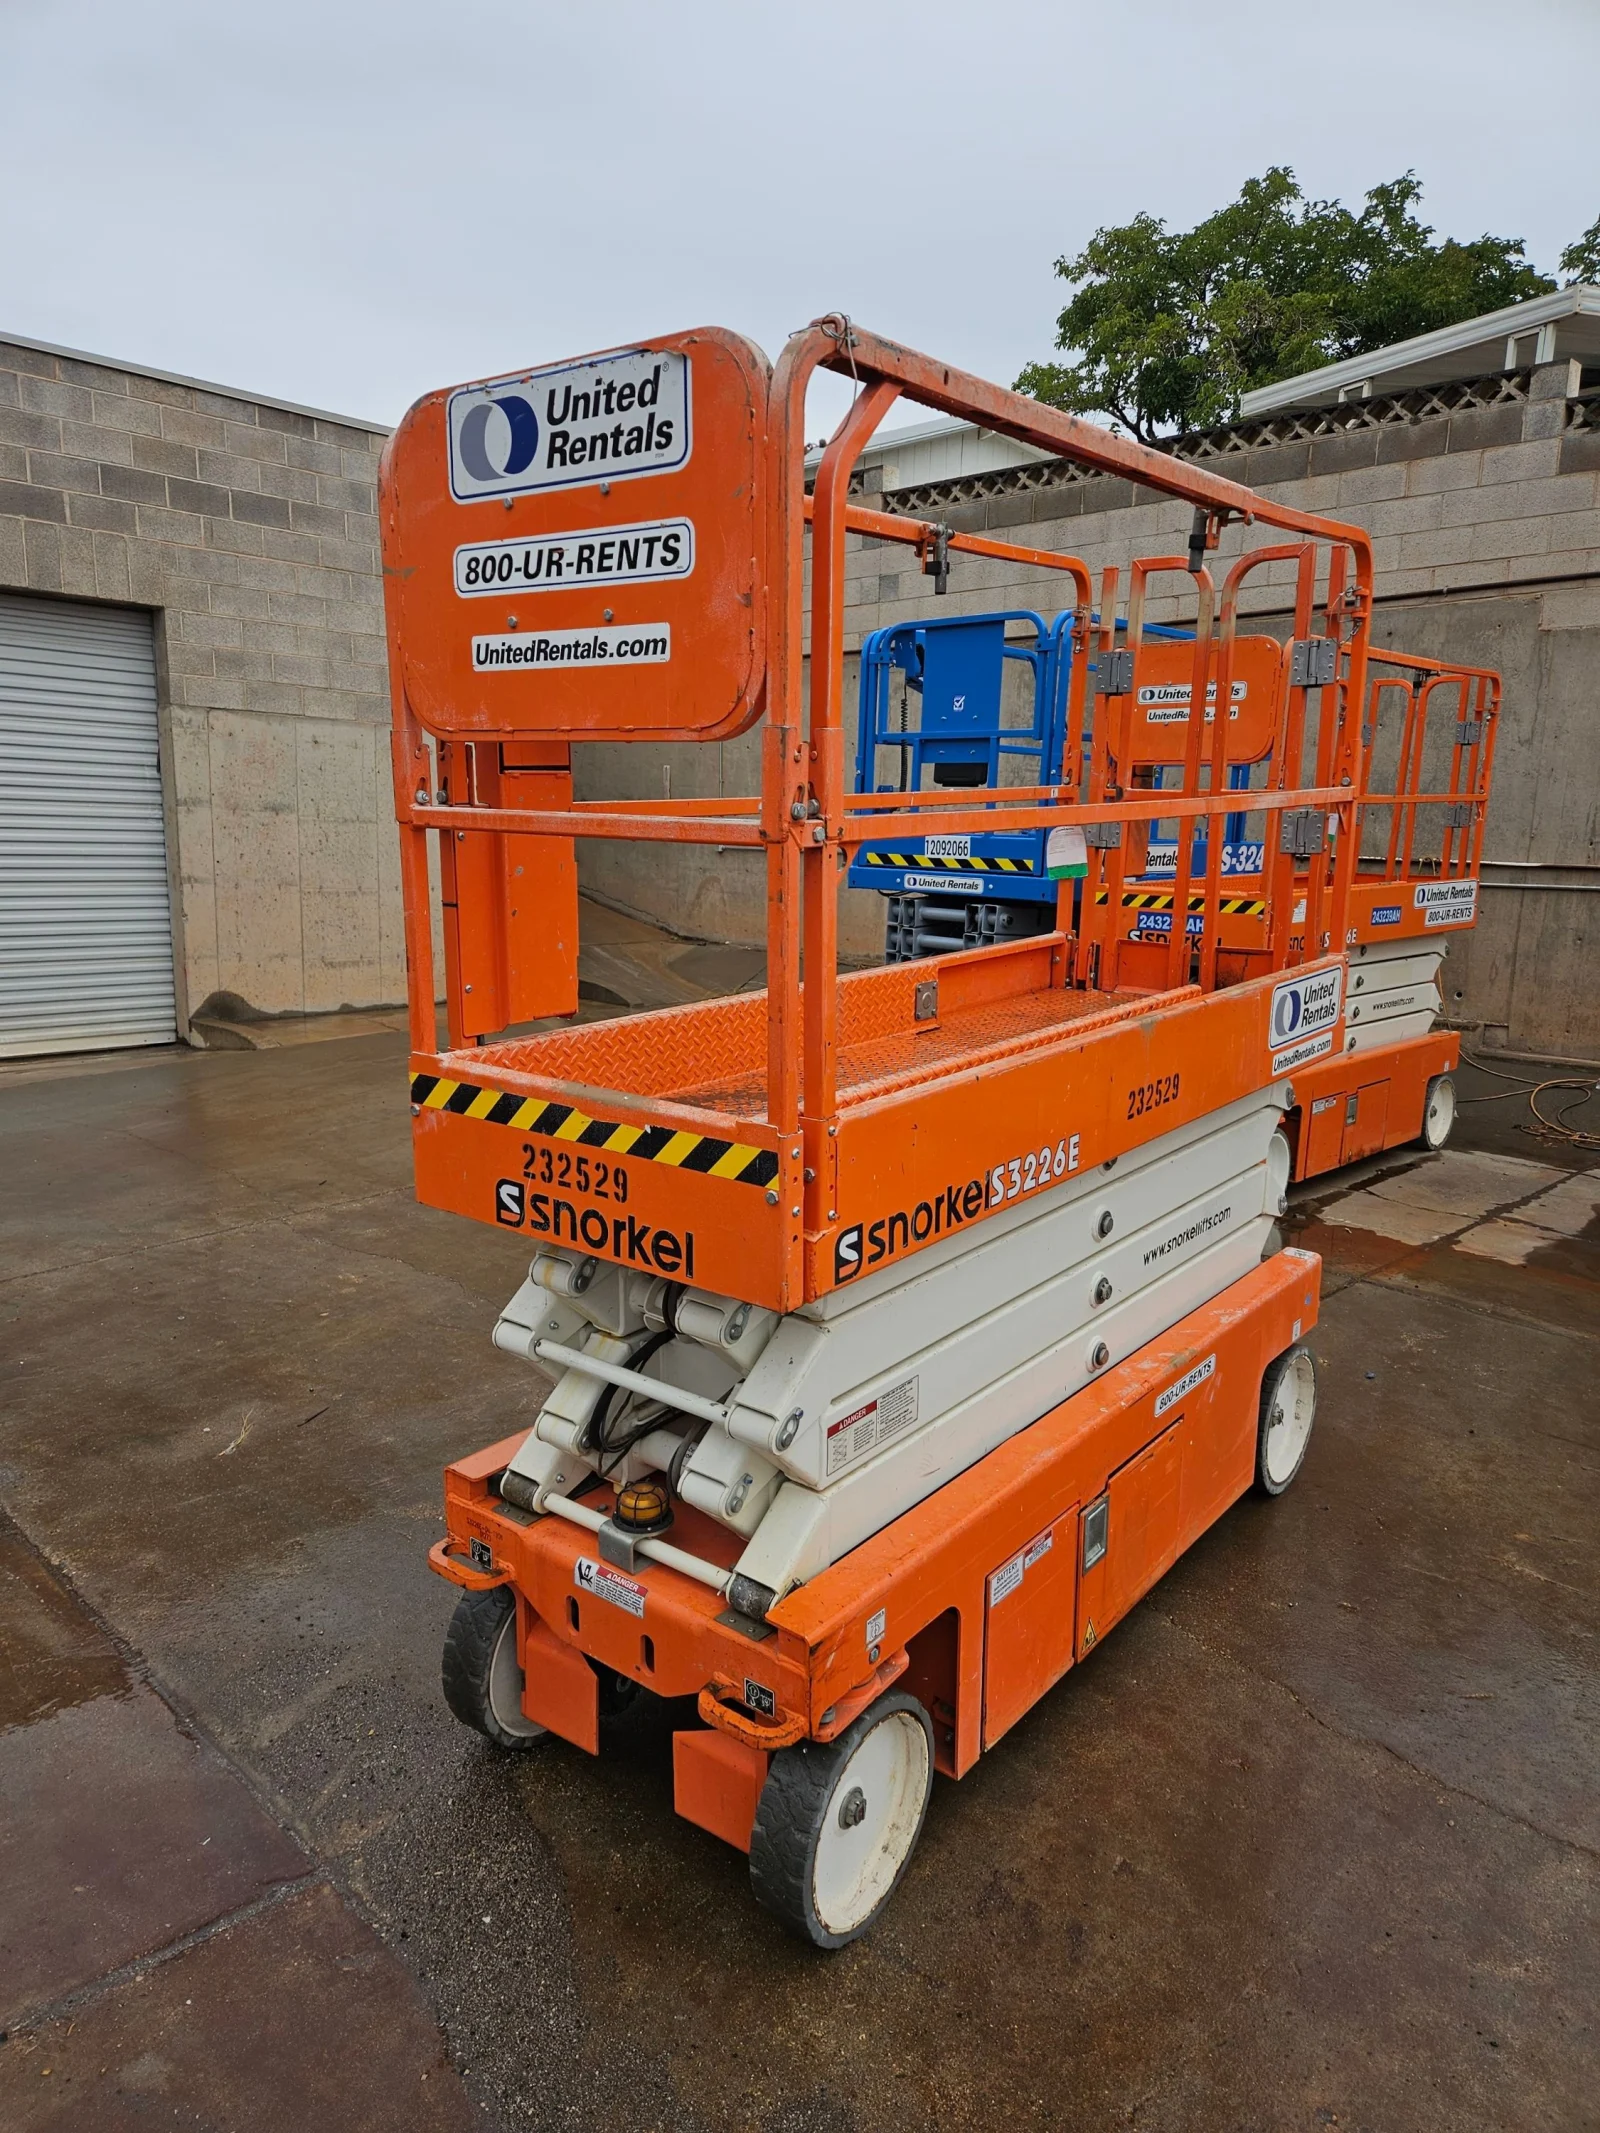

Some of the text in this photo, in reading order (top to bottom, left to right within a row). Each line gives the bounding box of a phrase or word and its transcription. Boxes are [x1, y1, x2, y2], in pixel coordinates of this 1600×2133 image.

[546, 364, 661, 426] United
[546, 411, 674, 469] Rentals
[465, 533, 682, 585] 800-UR-RENTS
[475, 635, 668, 665] UnitedRentals.com
[925, 839, 969, 857] 12092066
[918, 877, 979, 891] United Rentals
[1426, 884, 1474, 903] United Rentals
[1427, 906, 1473, 923] 800-UR-RENTS
[1303, 976, 1336, 1006] United
[1301, 998, 1336, 1028] Rentals
[1273, 1038, 1331, 1073] UnitedRentals.com
[1127, 1072, 1180, 1121] 232529
[522, 1143, 628, 1204] 232529
[867, 1169, 991, 1265] snorkel
[989, 1132, 1081, 1208] S3226E
[530, 1192, 694, 1279] snorkel
[1142, 1206, 1232, 1267] www.snorkellifts.com
[1159, 1360, 1213, 1411] 800-UR-RENTS
[843, 1408, 868, 1428] DANGER
[611, 1573, 640, 1593] DANGER
